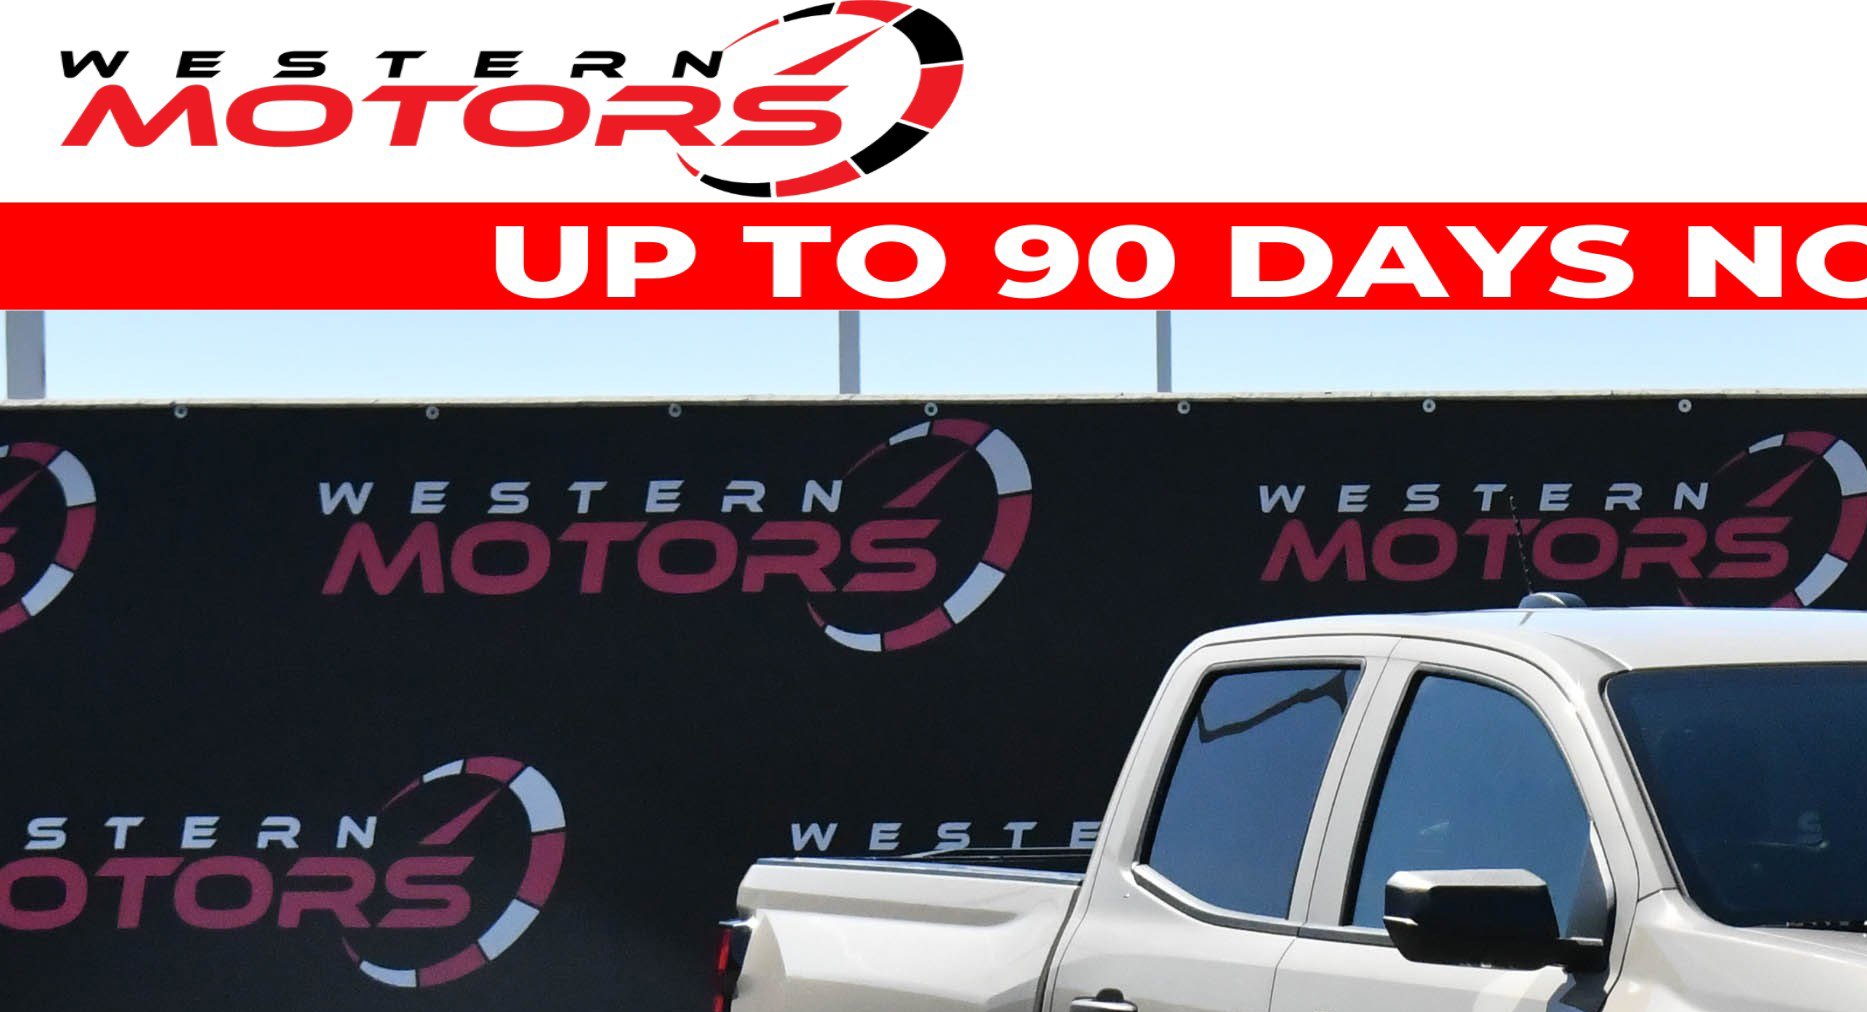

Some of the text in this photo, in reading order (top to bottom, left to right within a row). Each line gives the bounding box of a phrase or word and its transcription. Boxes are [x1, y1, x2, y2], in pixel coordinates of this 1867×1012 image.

[320, 480, 842, 515] WESTERN
[1260, 482, 1708, 513] WESTERN
[320, 519, 940, 595] MOTORS
[1261, 517, 1790, 582] MOTORS
